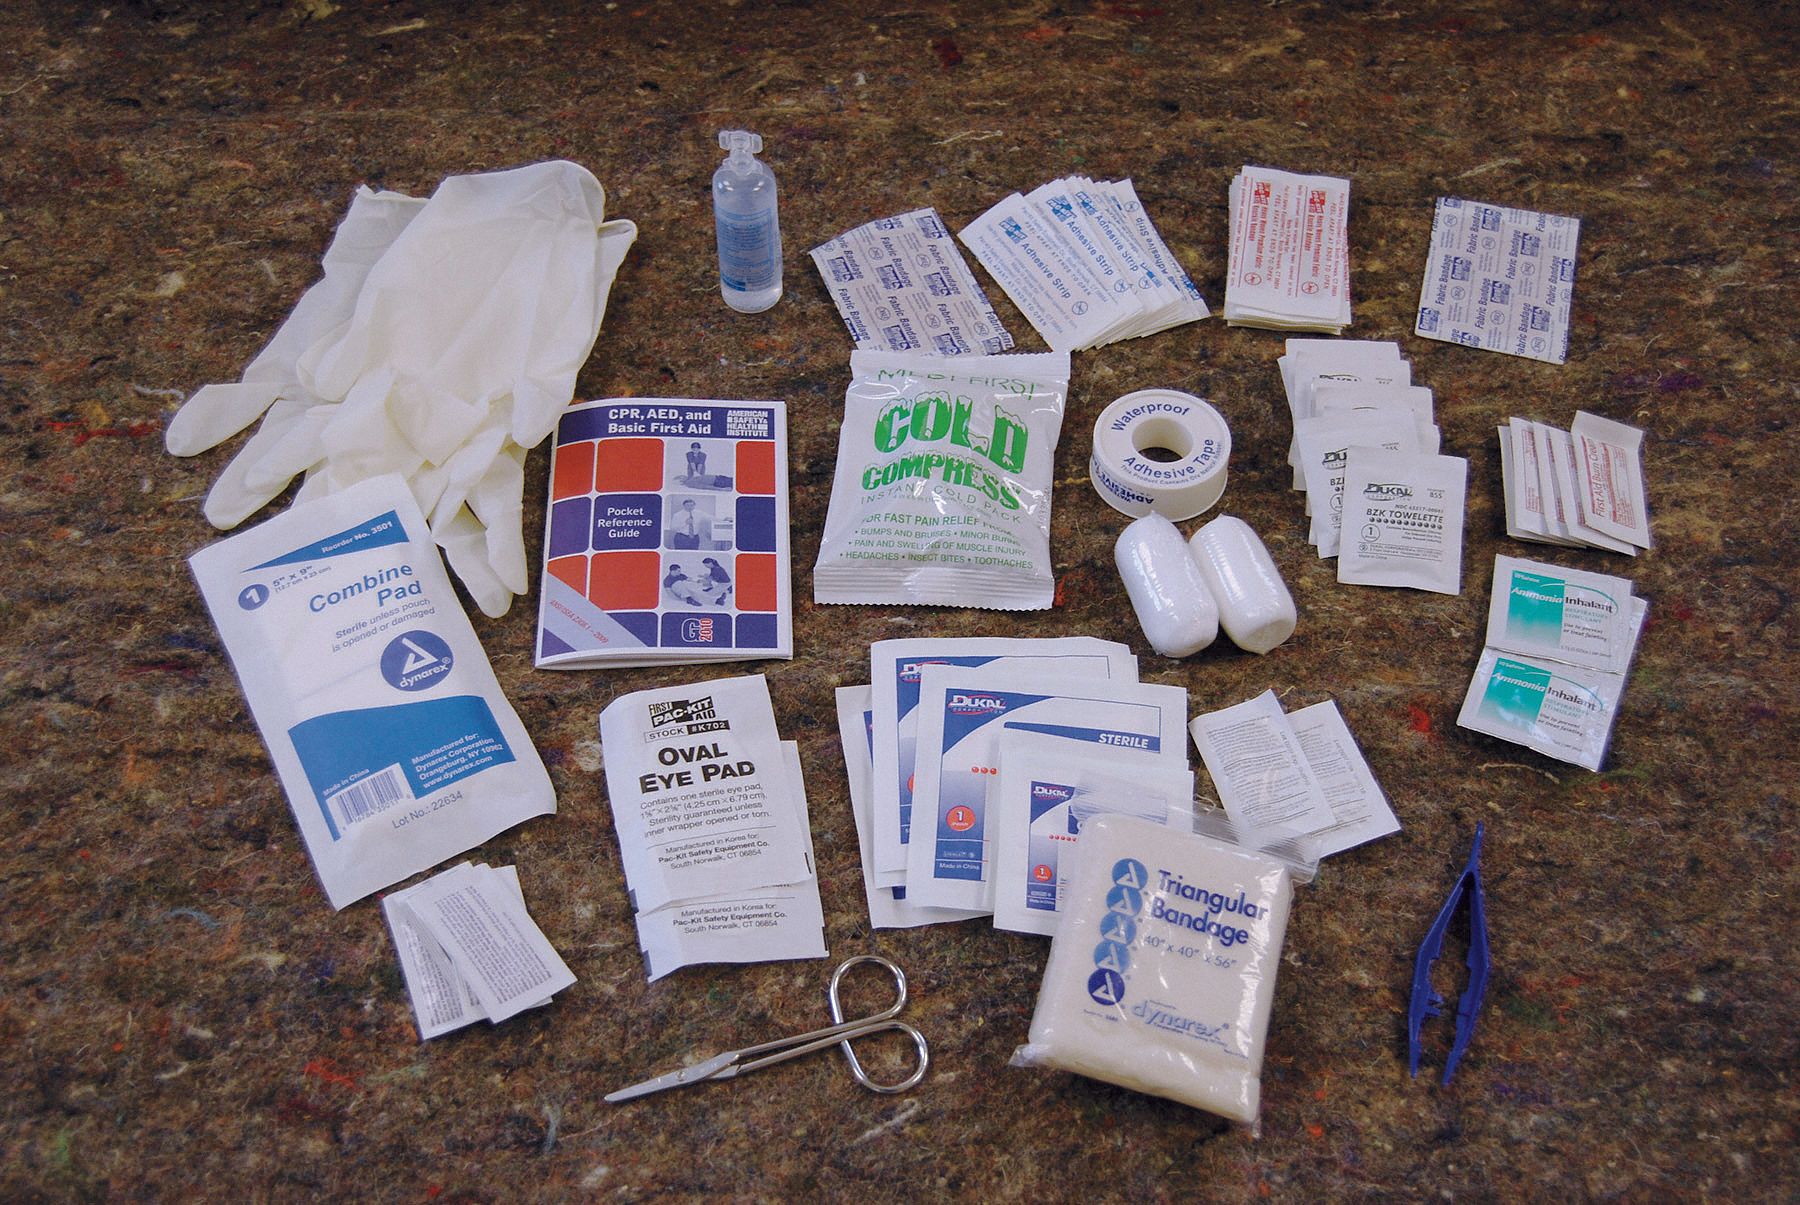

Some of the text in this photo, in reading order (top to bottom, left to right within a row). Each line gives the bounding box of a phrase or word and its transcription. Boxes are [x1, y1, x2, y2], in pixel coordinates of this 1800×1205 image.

[1466, 206, 1482, 254] Fabric Bandage
[1066, 218, 1114, 277] Adhesive Strip
[1095, 214, 1139, 273] Adhesive Strip
[1136, 217, 1168, 276] Adhesive Strip
[880, 237, 913, 288] Fabric Bandage
[927, 244, 961, 295] Fabric Bandage
[1021, 242, 1071, 300] Adhesive Strip
[1435, 254, 1452, 305] Fabric Bandage
[838, 288, 871, 341] Fabric Bandage
[608, 408, 712, 422] CPR, AED, and
[726, 410, 768, 418] AMERICAN
[1111, 403, 1190, 432] Waterproof
[608, 422, 711, 434] Basic First Aid
[874, 390, 1029, 474] COLD
[1124, 456, 1195, 479] Adhesive
[1192, 439, 1214, 466] Tape
[861, 450, 1021, 511] COMPRESS
[1363, 483, 1413, 497] DUKAL
[607, 508, 644, 516] Pocket
[934, 485, 1021, 524] COLD PACK
[1367, 508, 1444, 523] BZK TOWELETTE
[597, 518, 652, 528] Reference
[884, 513, 912, 524] FAST
[914, 515, 939, 526] PAIN
[1369, 527, 1372, 535] 1
[321, 521, 393, 554] Reorder No. 3501
[608, 529, 640, 538] Guide
[860, 528, 892, 536] BUMPS
[893, 529, 913, 538] AND
[914, 529, 951, 538] BRUISES
[959, 530, 990, 540] MINOR
[846, 551, 899, 560] HEADACHES
[940, 554, 965, 563] BITES
[974, 556, 1033, 569] TOOTHACHES
[854, 540, 1026, 557] PAIN AND OF MUSCLE INJURY
[246, 588, 262, 604] 1
[309, 564, 412, 613] Combine
[377, 580, 422, 607] Pad
[1511, 587, 1613, 613] Ammonia Inhalant
[332, 607, 436, 652] is opened or damaged
[335, 598, 431, 639] Sterile unless pouch
[700, 618, 712, 642] 2010
[948, 695, 1006, 709] DUKAL
[1492, 672, 1546, 692] Ammonia
[1547, 687, 1597, 711] Inhalant
[649, 701, 672, 715] FIRST
[696, 709, 716, 721] AID
[649, 722, 726, 739] STOCK #K702
[1098, 733, 1149, 749] STERILE
[411, 732, 480, 764] Manufactured for:
[415, 737, 494, 773] Dynarex Corporation
[468, 749, 480, 758] NY
[658, 742, 728, 766] OVAL
[322, 783, 341, 796] Made
[349, 768, 370, 781] China
[423, 755, 492, 789] www.dynarex.com
[640, 761, 755, 794] EYE PAD
[640, 796, 679, 810] Contains
[699, 786, 725, 799] sterile
[727, 785, 742, 795] eye
[744, 783, 763, 793] pad,
[683, 800, 706, 812] (4.25
[706, 798, 720, 806] cm
[729, 794, 748, 803] 6.79
[1032, 786, 1071, 798] DUKAL
[392, 790, 463, 829] Lot No.: 22634
[649, 815, 684, 827] Sterility
[683, 807, 733, 822] guaranteed
[735, 802, 762, 811] unless
[956, 810, 964, 822] 1
[644, 828, 665, 838] inner
[667, 820, 703, 833] wrapper
[705, 815, 738, 826] opened
[658, 853, 687, 863] Pac-Kit
[689, 849, 713, 858] Safety
[715, 843, 756, 853] Equipment
[665, 840, 716, 854] Manufactured
[670, 861, 692, 870] South
[694, 854, 726, 864] Norwalk,
[1157, 869, 1269, 921] Triangular
[1151, 897, 1249, 947] Bandage
[1213, 954, 1237, 969] 56"
